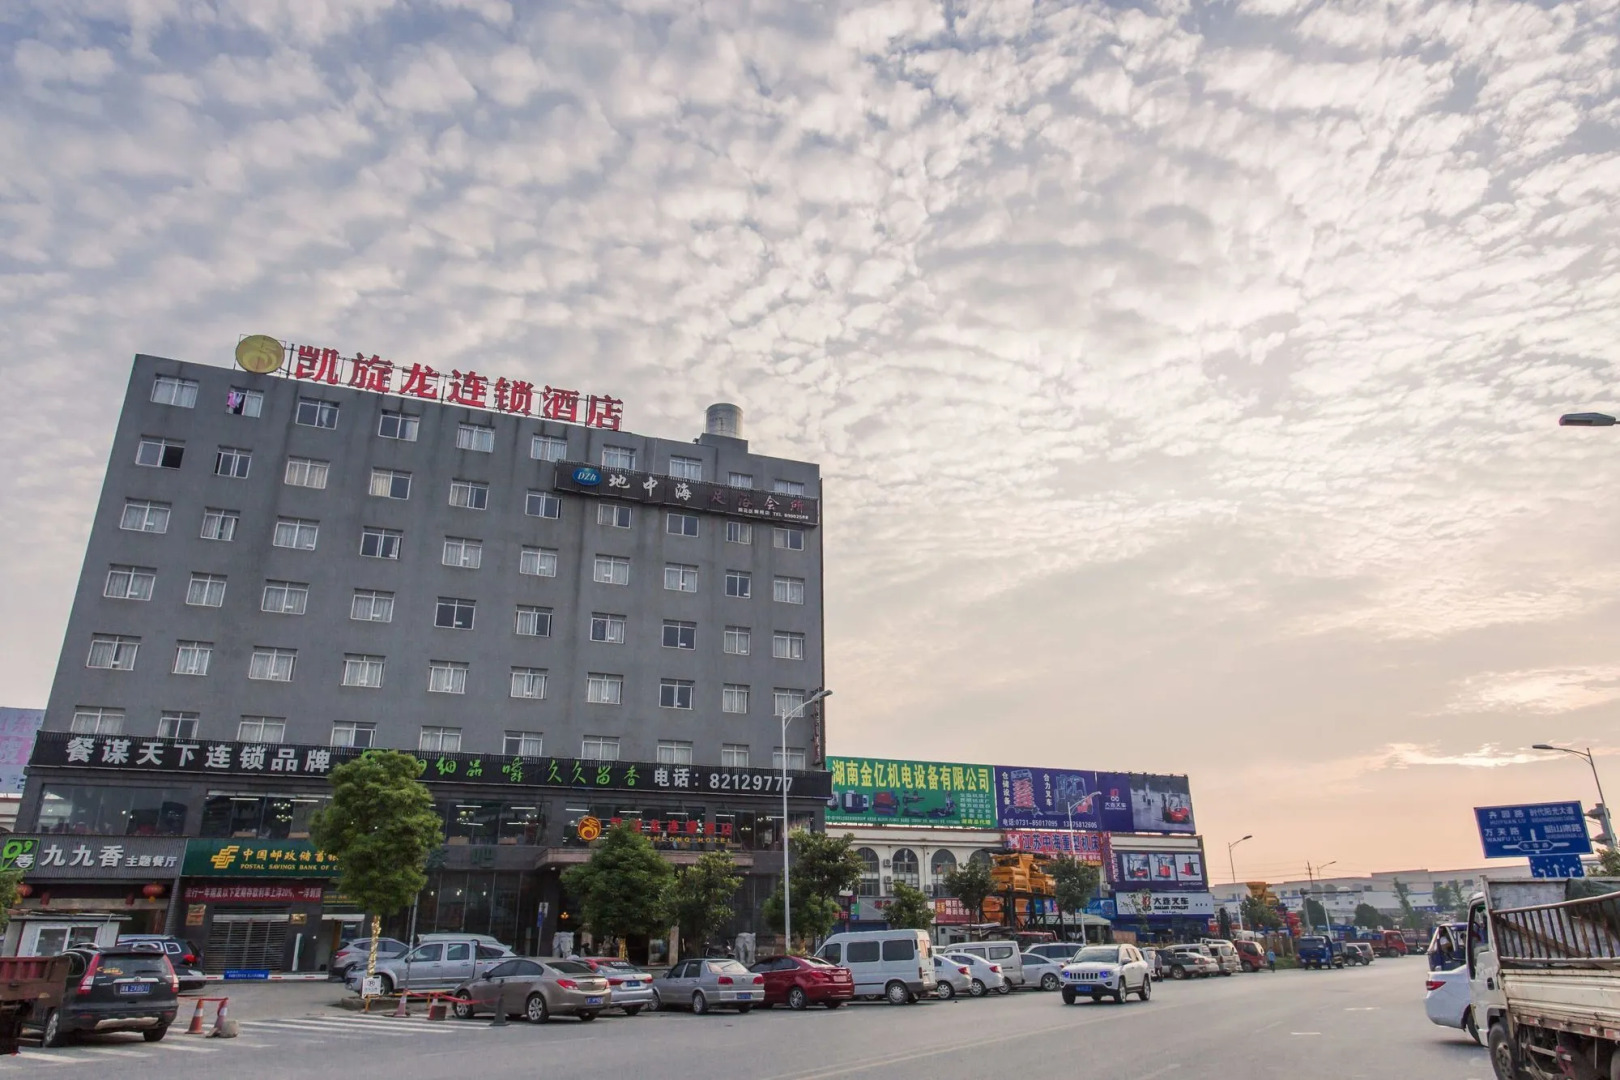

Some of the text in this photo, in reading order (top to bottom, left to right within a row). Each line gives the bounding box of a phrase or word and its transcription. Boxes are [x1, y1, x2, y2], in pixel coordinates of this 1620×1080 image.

[295, 344, 624, 431] 凯旋龙连锁酒店
[66, 737, 330, 772] 餐谋天下连锁品牌
[832, 759, 989, 793] 湖南金亿机电设备有限公司
[1043, 773, 1052, 806] 合力叉车
[1530, 806, 1575, 817] 时代阳光大道
[40, 844, 177, 868] 九九香 主题餐厅
[1153, 897, 1189, 906] 大连叉车
